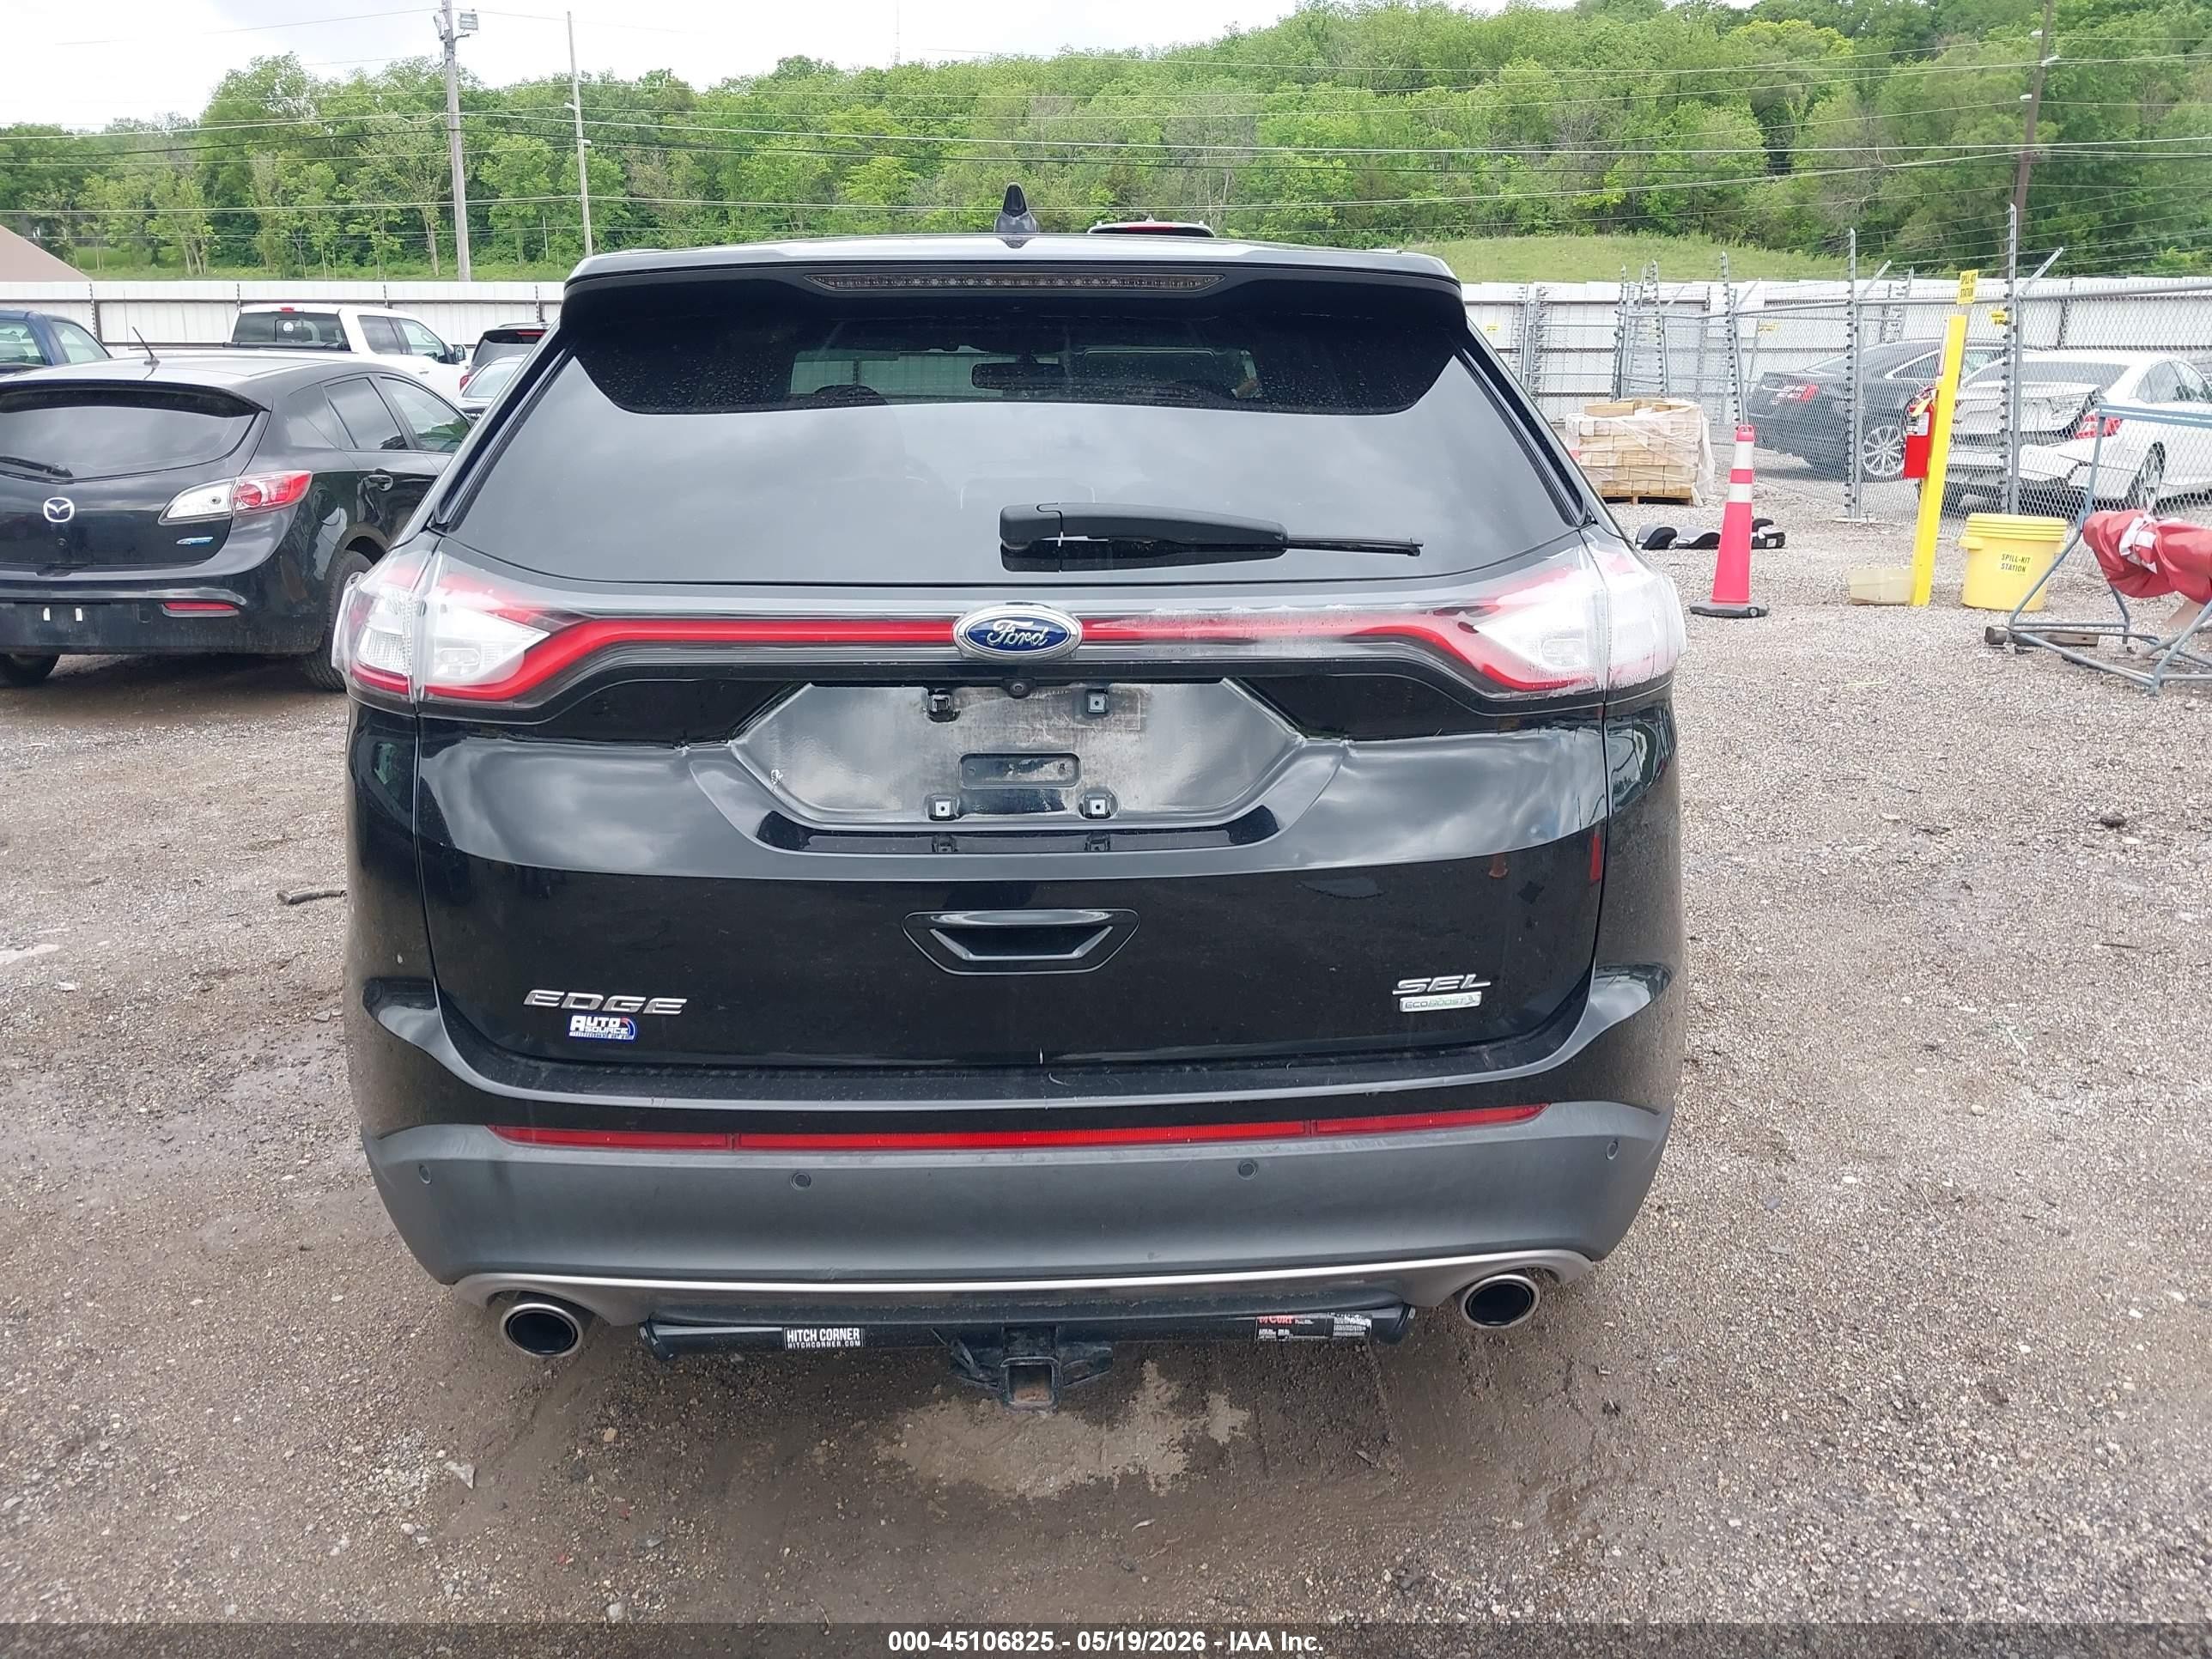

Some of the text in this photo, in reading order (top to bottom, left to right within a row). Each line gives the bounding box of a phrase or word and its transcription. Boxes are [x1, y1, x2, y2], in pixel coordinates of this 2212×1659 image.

[2001, 553, 2031, 564] SPILL-KIT
[2001, 562, 2027, 574] STATION
[988, 619, 1049, 647] Ford
[1392, 973, 1492, 995] SEL
[523, 988, 688, 1016] EDGE
[569, 1015, 621, 1032] AUTO
[585, 1025, 629, 1036] SOURCE
[787, 1328, 860, 1343] HITCH CORNER
[787, 1340, 861, 1349] HITCHCORNER.COM
